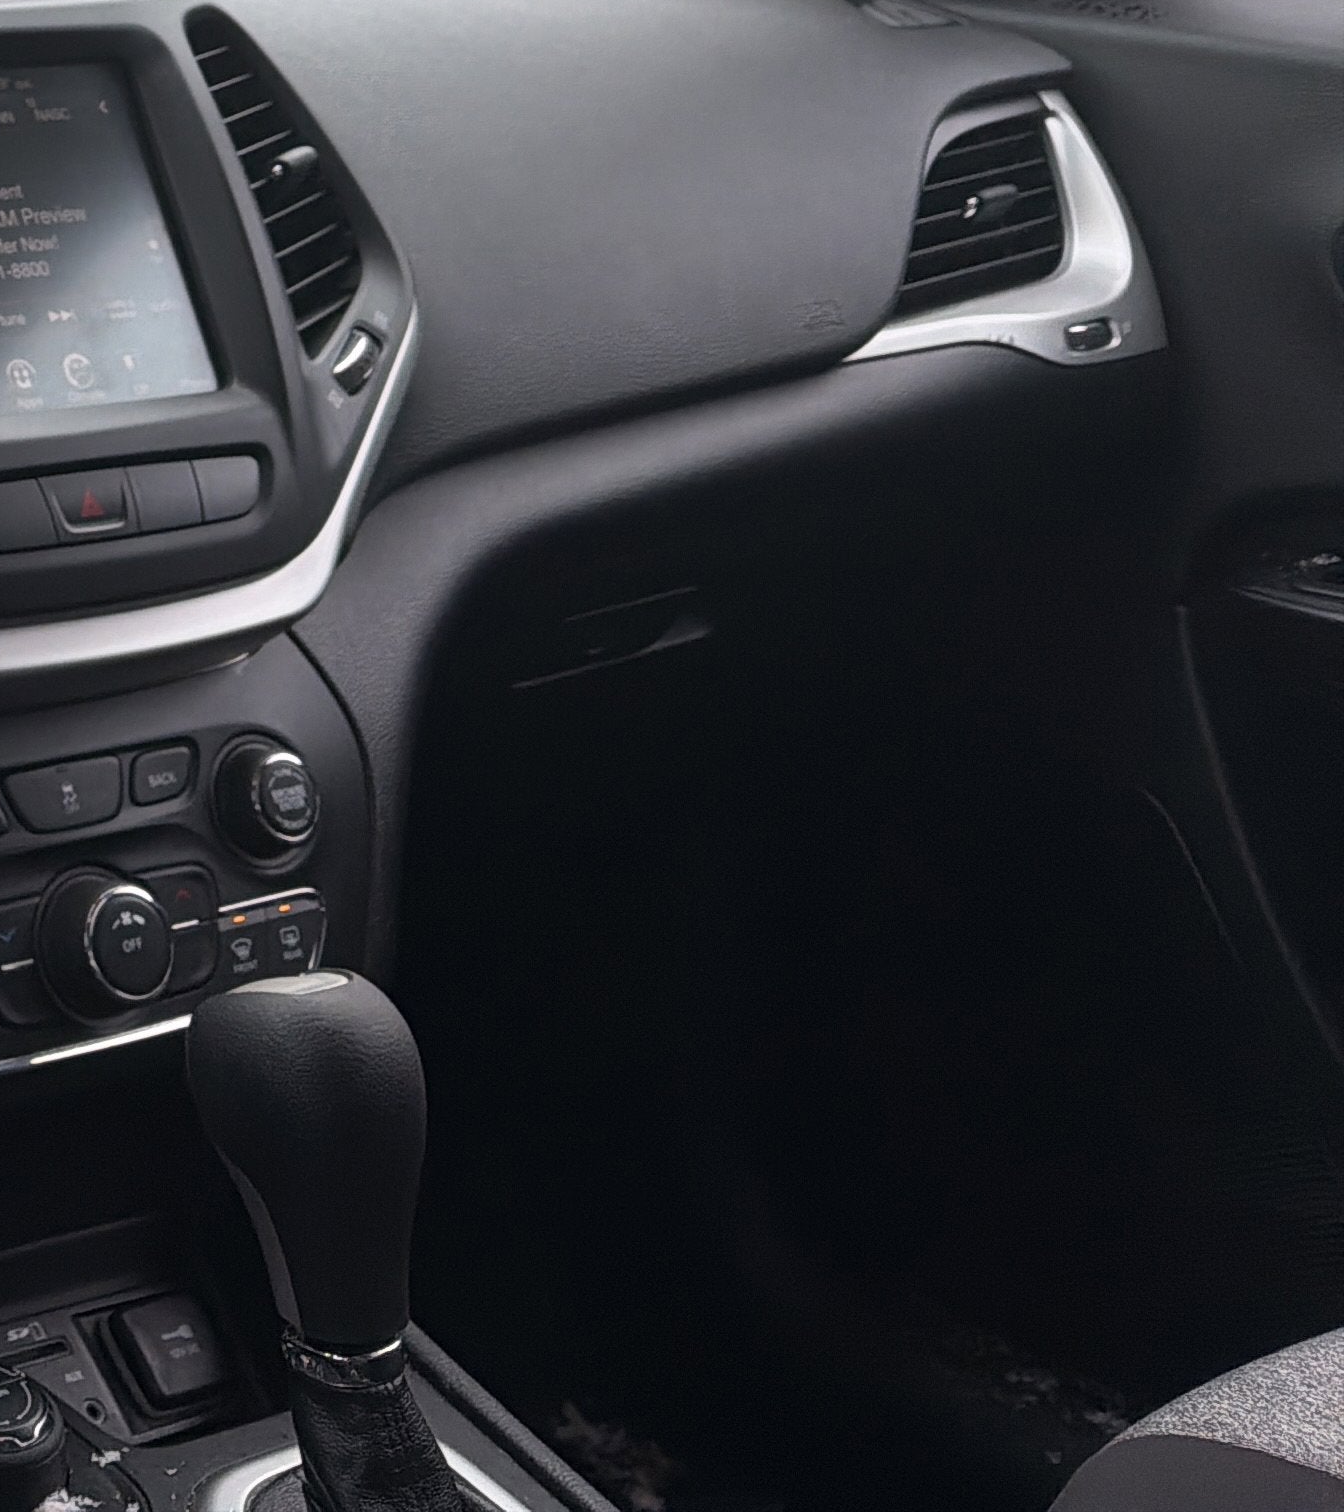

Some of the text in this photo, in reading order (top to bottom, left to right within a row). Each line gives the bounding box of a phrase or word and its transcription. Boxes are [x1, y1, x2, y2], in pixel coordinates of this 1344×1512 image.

[21, 207, 89, 226] Preview
[148, 772, 177, 788] BACK
[121, 936, 143, 953] OFF
